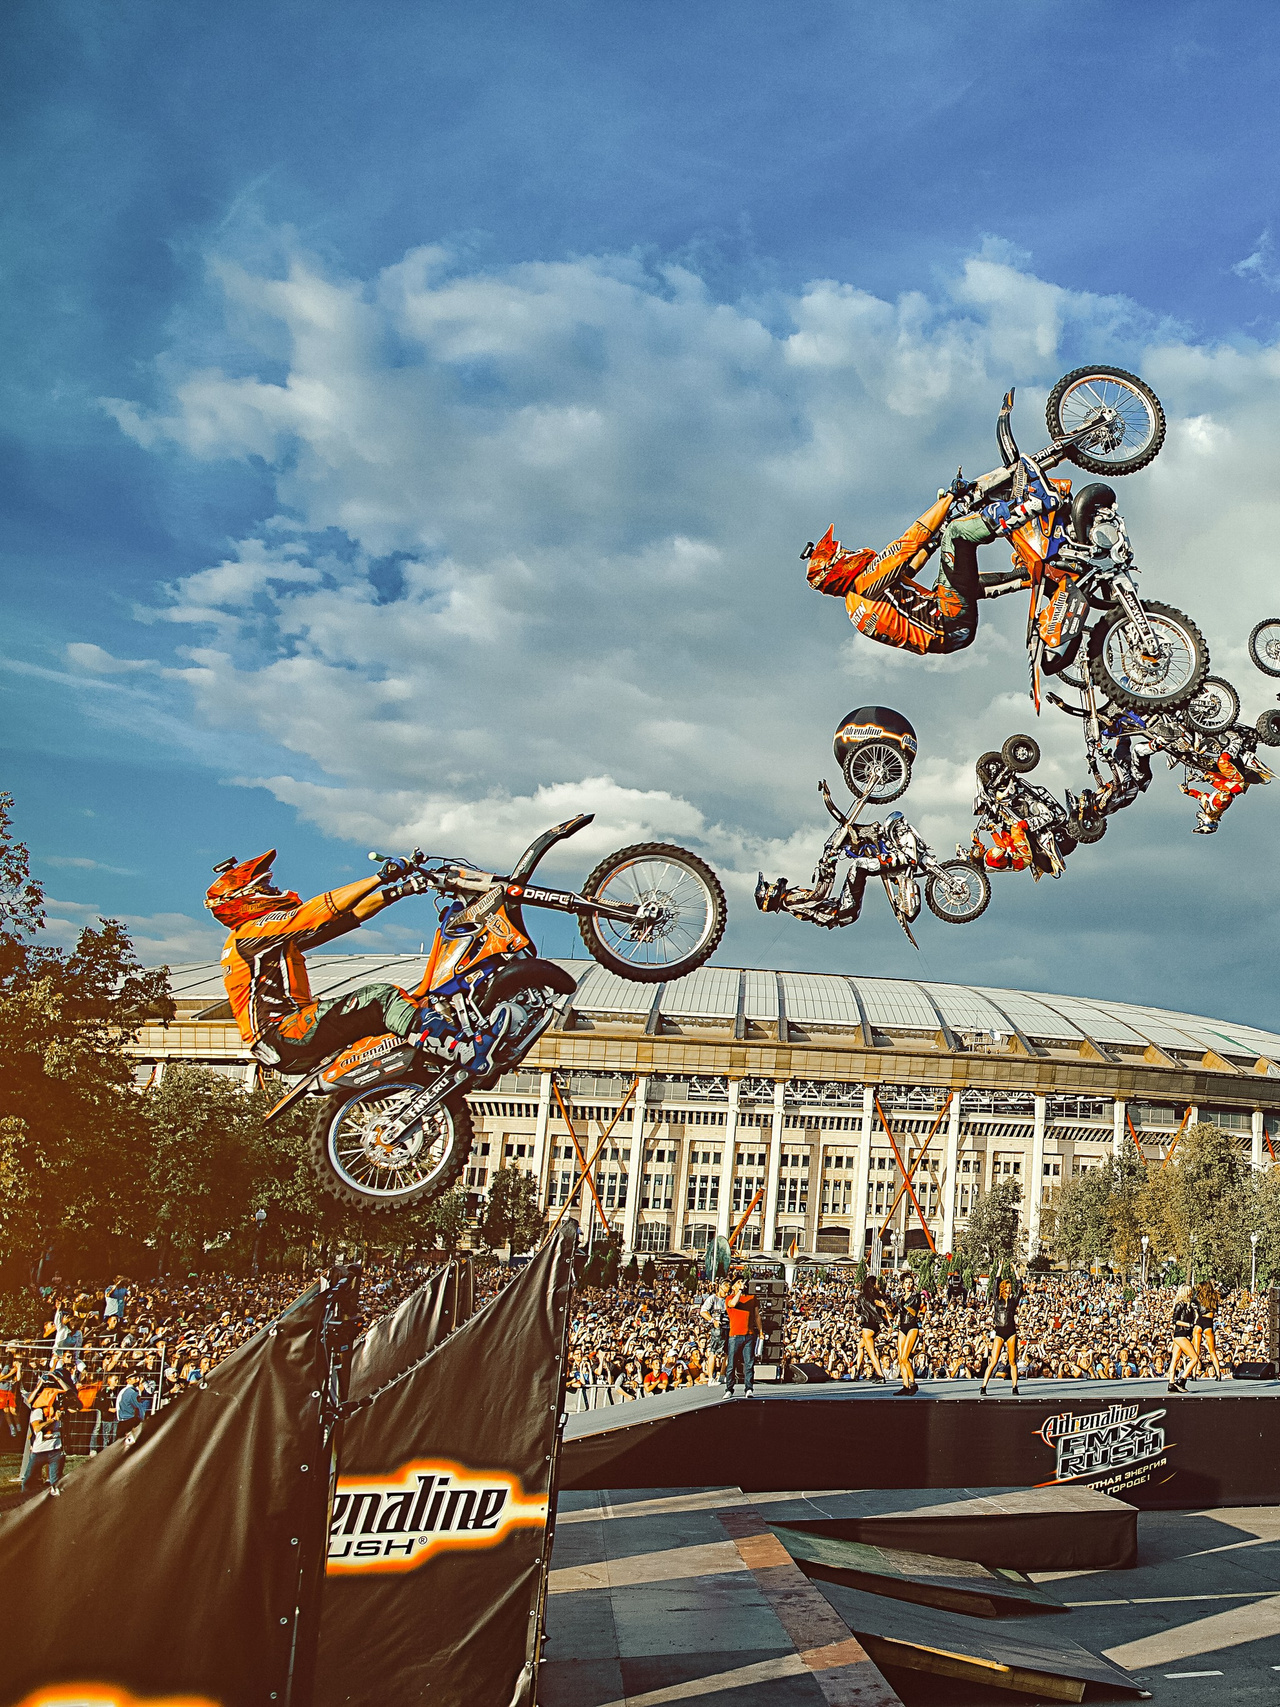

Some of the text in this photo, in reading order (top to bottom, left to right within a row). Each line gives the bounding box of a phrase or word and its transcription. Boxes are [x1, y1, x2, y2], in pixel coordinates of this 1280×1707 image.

[1036, 1404, 1139, 1448] Adrenaline
[1060, 1409, 1166, 1454] FMX
[1058, 1430, 1164, 1479] RUSH
[1124, 1458, 1167, 1480] ЭНЕРГИЯ
[1107, 1474, 1151, 1495] ГОРОДЕ!
